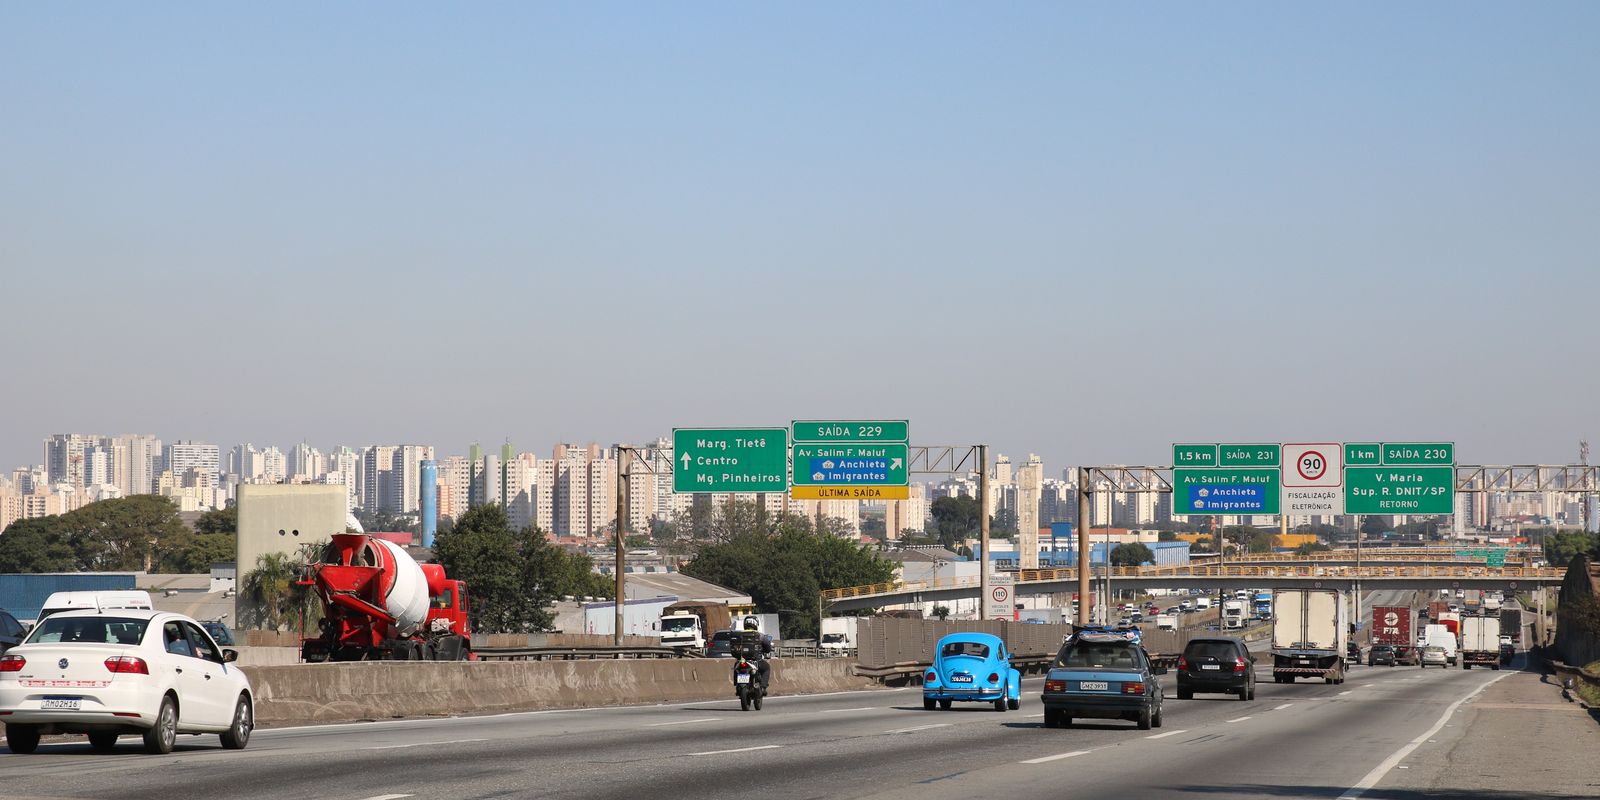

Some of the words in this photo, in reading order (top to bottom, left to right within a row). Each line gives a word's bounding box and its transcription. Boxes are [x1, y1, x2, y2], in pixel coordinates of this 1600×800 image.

[818, 424, 850, 436] SAÍDA
[859, 426, 882, 436] 229
[697, 440, 730, 450] Marg.
[736, 438, 766, 448] Tietê
[1196, 452, 1212, 460] km
[1226, 449, 1251, 460] SAÍDA
[1257, 452, 1274, 460] 231
[1350, 450, 1354, 458] 1
[1358, 450, 1374, 458] km
[1389, 448, 1420, 458] SAÍDA
[1424, 450, 1447, 458] 230
[697, 456, 738, 464] Centro
[840, 460, 886, 468] Anchieta
[1304, 458, 1320, 470] 90
[697, 474, 718, 486] Mg.
[722, 474, 780, 482] Pinheiros
[828, 472, 886, 482] Imigrantes
[818, 486, 850, 496] ÚLTIMA
[854, 486, 880, 496] SAÍDA
[1288, 492, 1336, 500] FISCALIZAÇÃO
[1353, 488, 1378, 497] Sup.
[1396, 488, 1446, 496] DNIT/SP
[1208, 501, 1260, 510] Imigrantes
